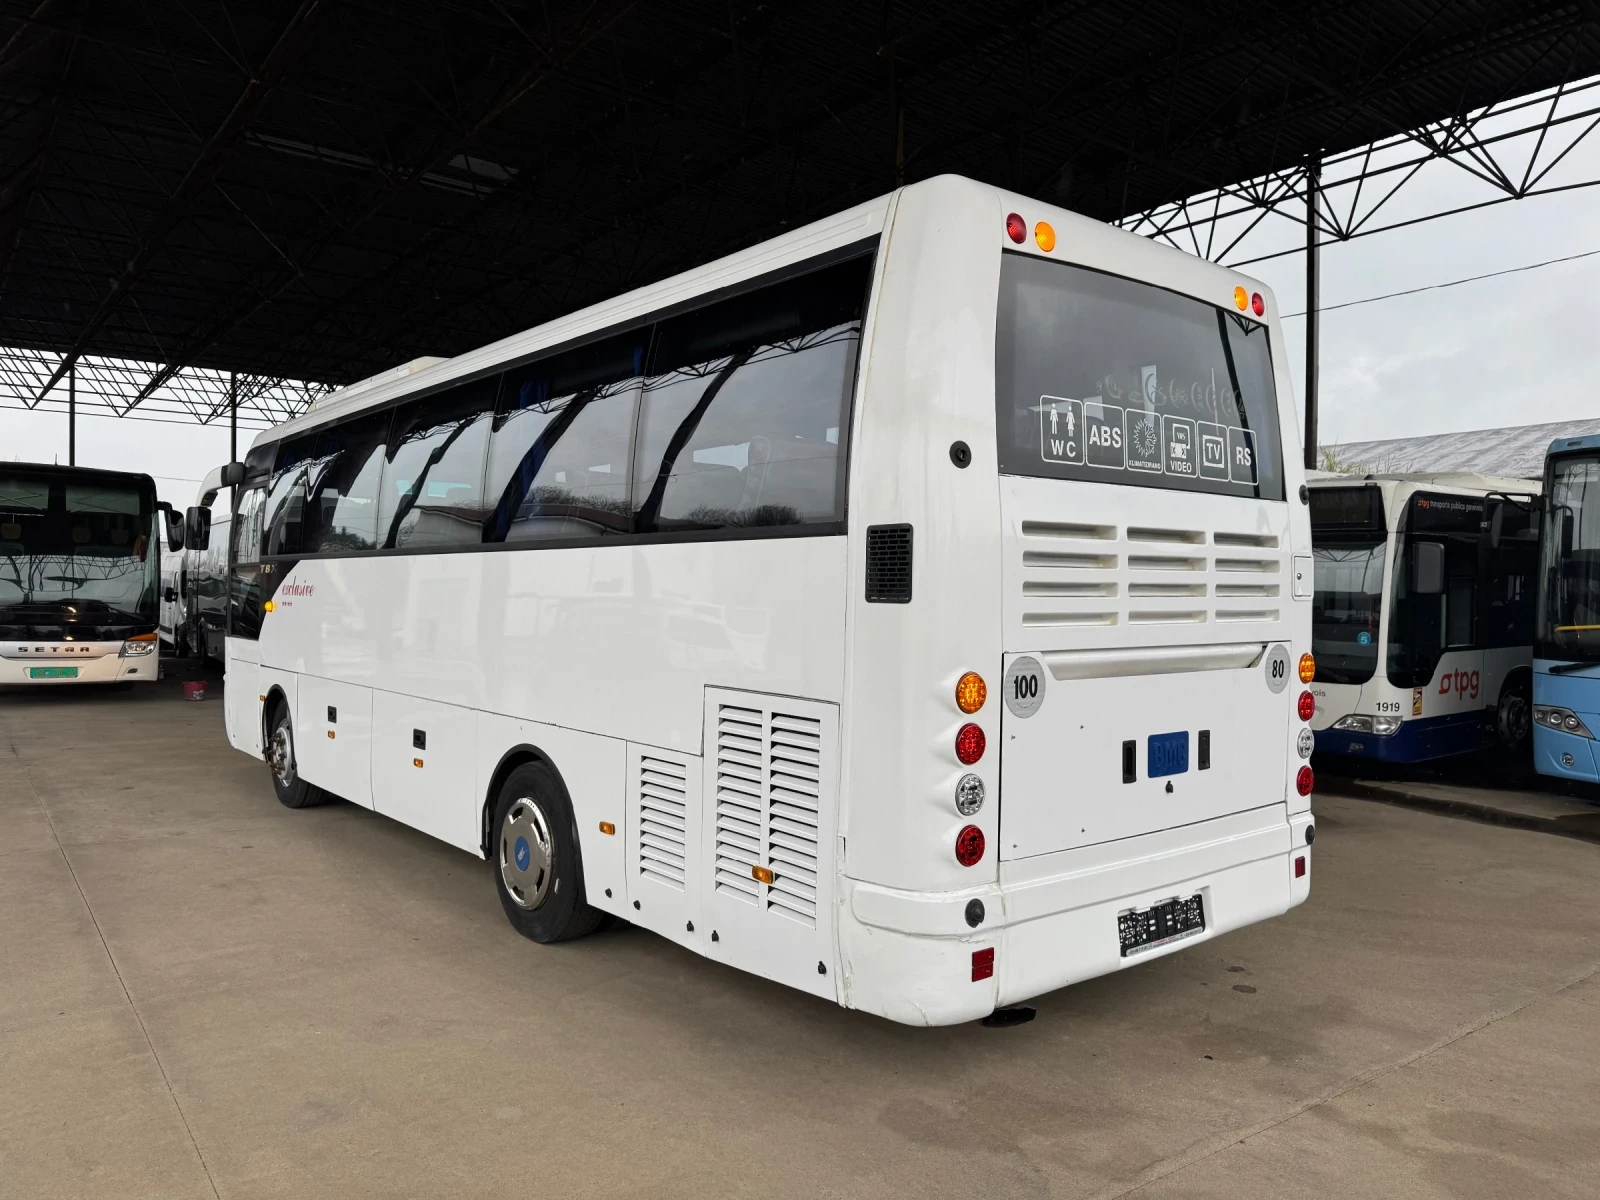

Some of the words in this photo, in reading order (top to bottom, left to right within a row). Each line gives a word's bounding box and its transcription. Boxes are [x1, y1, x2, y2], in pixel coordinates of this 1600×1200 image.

[1089, 424, 1122, 448] ABS
[1050, 438, 1076, 458] WC
[1206, 442, 1220, 460] TV
[1235, 446, 1252, 466] RS
[1170, 460, 1192, 473] VIDEO
[281, 575, 316, 597] exclusive
[1360, 636, 1368, 645] 5
[1272, 659, 1285, 679] 80
[1013, 674, 1038, 700] 100
[1453, 667, 1480, 700] tpg
[1376, 702, 1400, 712] 1919
